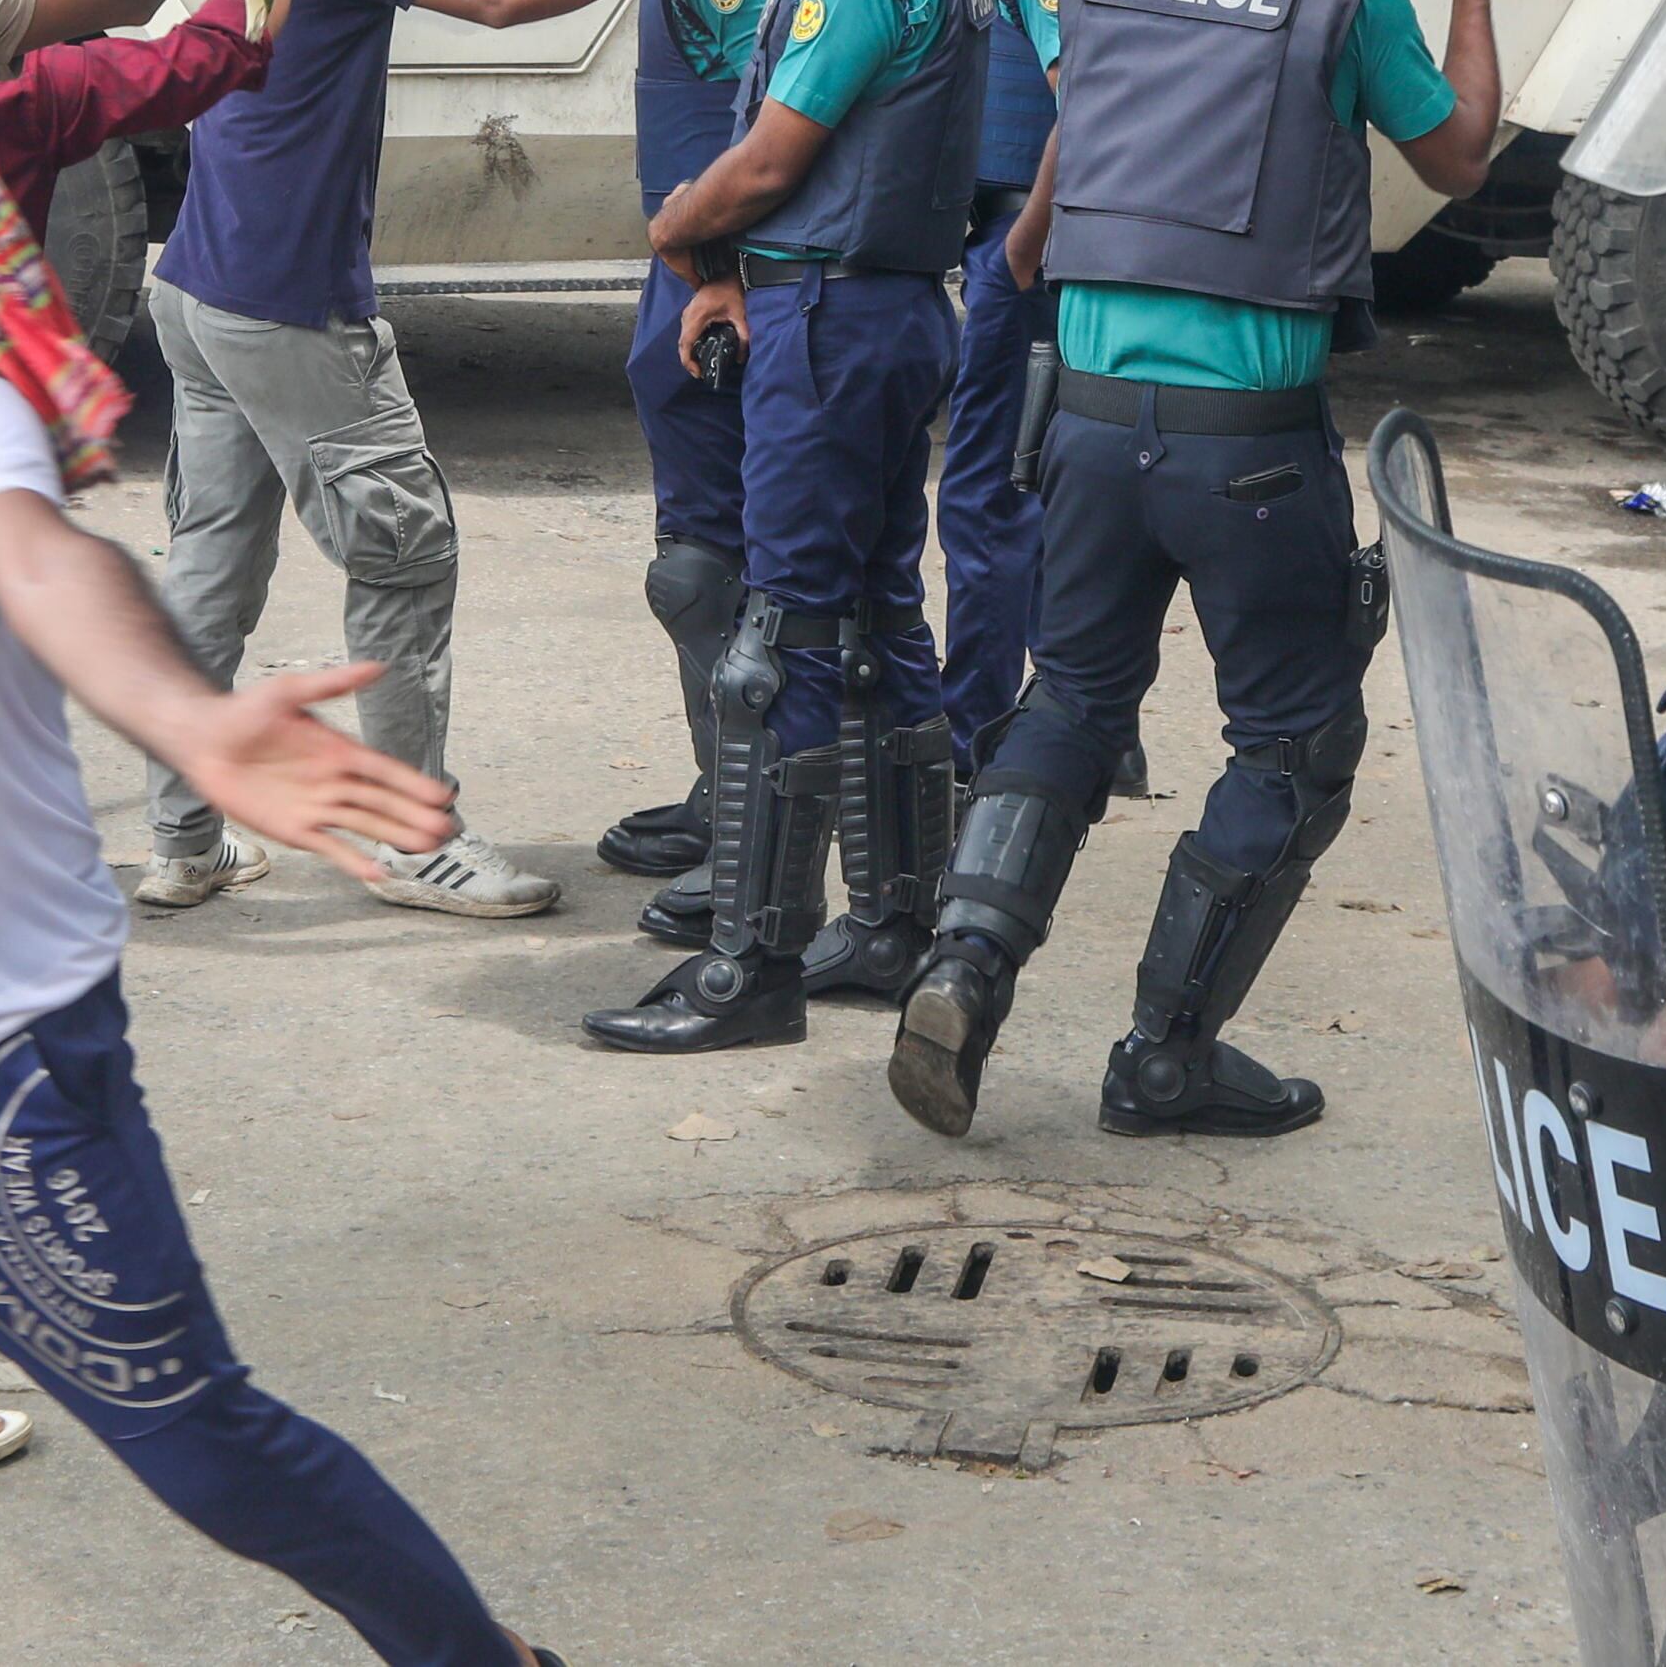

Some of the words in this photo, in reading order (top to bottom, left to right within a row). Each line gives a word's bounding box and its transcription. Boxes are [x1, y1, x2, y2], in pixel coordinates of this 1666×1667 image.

[0, 1136, 41, 1214] WEAR
[46, 1168, 110, 1243] 2016
[23, 1215, 119, 1296] SPORTS
